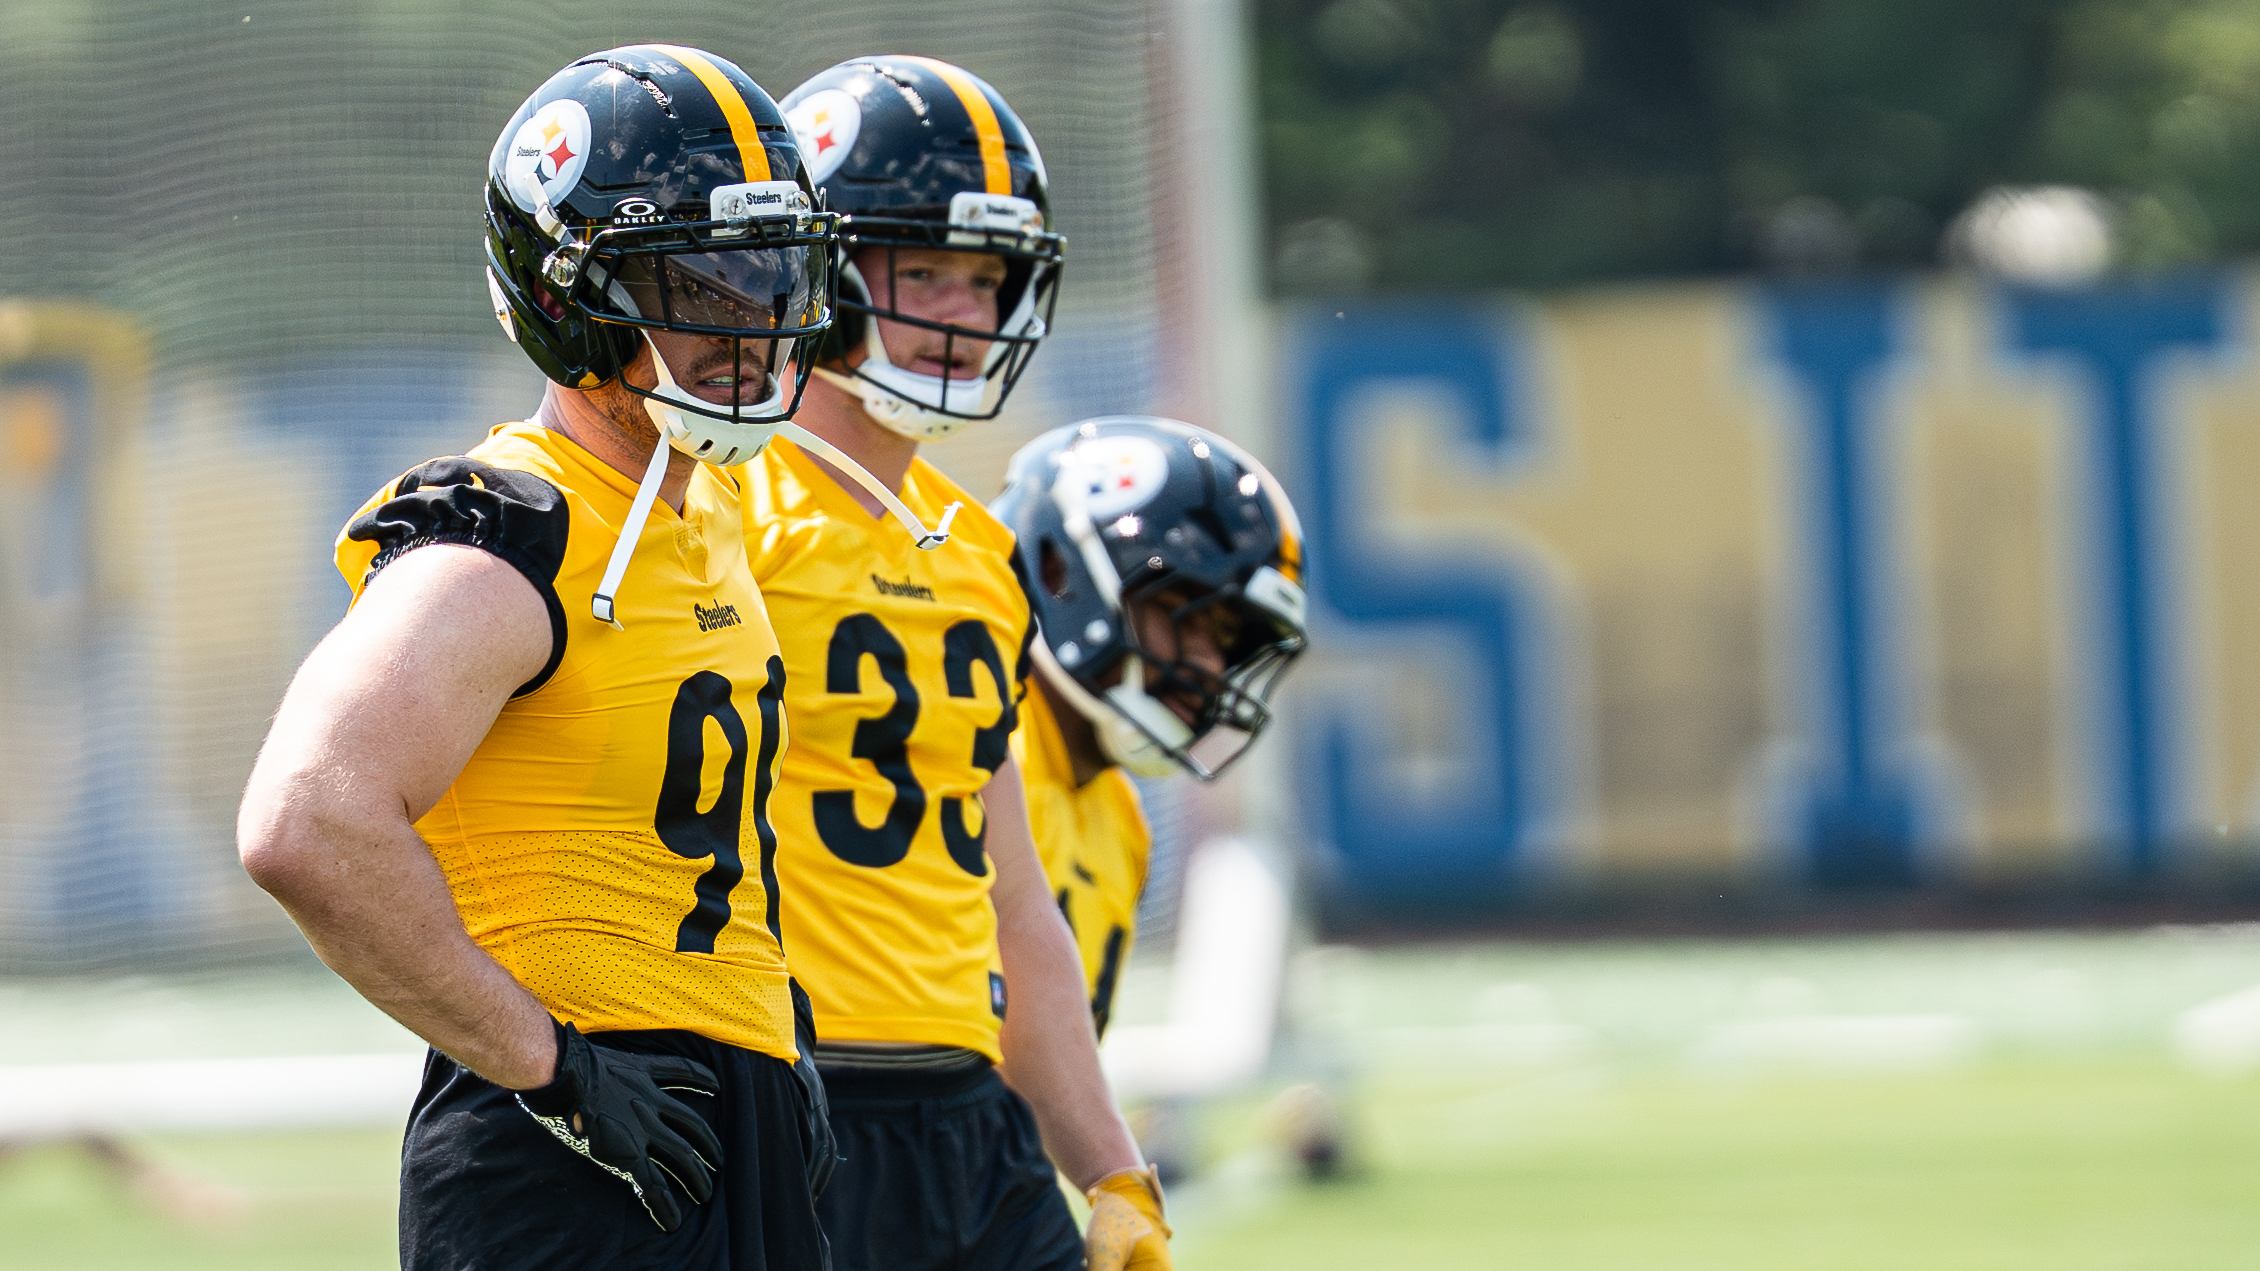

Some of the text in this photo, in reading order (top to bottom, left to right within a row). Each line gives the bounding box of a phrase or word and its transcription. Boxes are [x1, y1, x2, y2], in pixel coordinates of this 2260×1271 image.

[746, 190, 782, 206] Steelers
[614, 215, 666, 225] OAKLEY
[694, 598, 742, 633] Steelers
[812, 612, 1019, 877] 33
